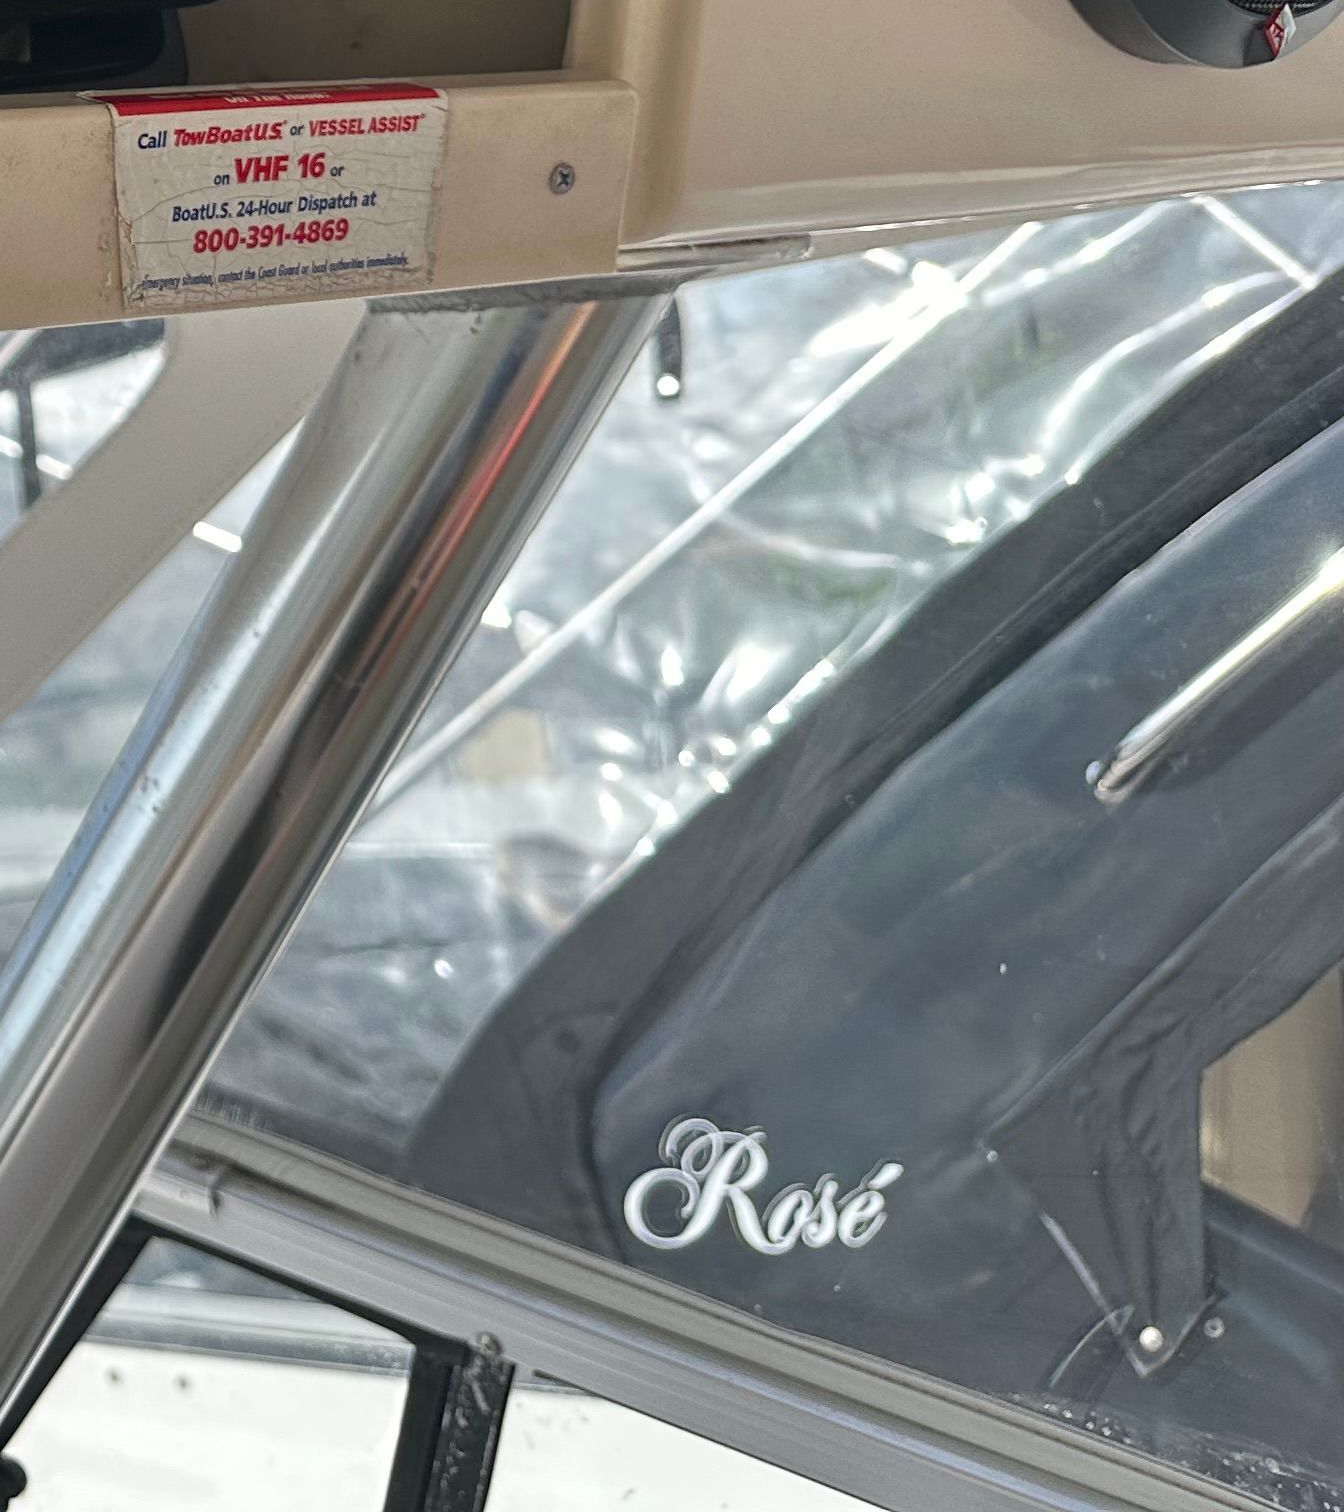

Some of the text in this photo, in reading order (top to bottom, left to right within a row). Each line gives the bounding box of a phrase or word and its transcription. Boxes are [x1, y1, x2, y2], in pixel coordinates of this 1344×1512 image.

[137, 129, 167, 149] Call
[289, 123, 305, 136] or
[308, 117, 365, 137] VESSEL
[214, 152, 345, 186] on VHF 16 or
[172, 191, 378, 223] BoatU.S. 24-Hour Dispatch at
[192, 218, 349, 254] 800-391-4869
[623, 1117, 905, 1256] Rosé
